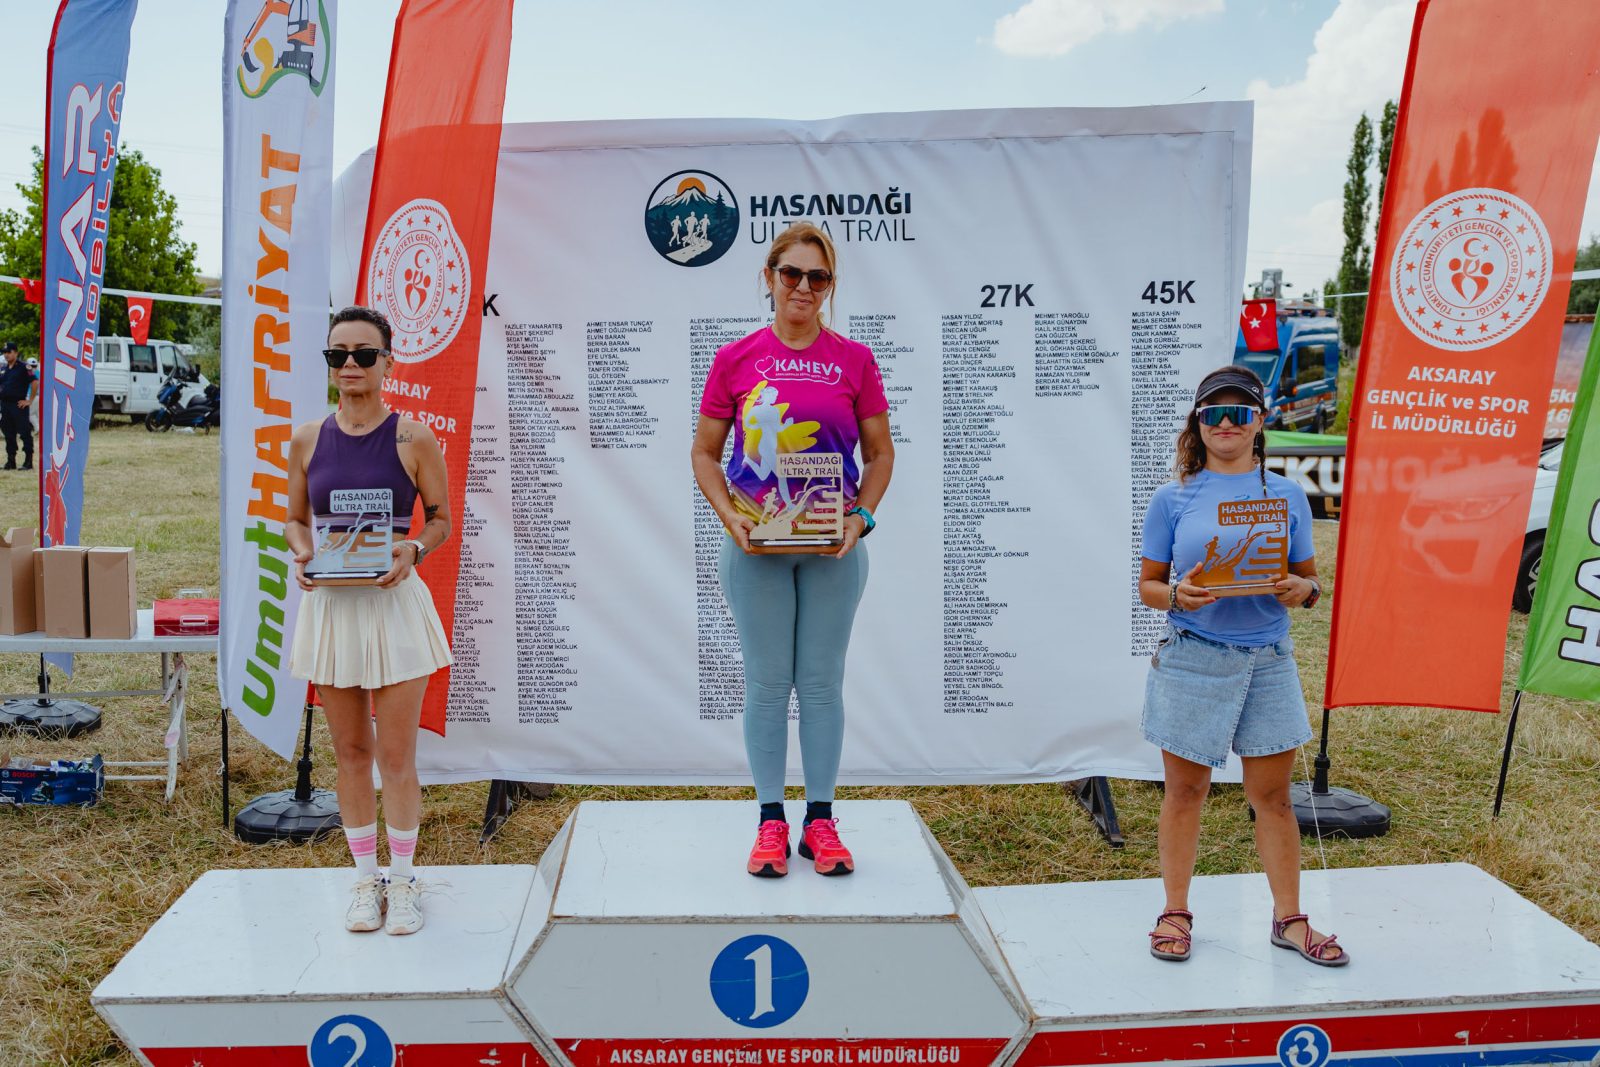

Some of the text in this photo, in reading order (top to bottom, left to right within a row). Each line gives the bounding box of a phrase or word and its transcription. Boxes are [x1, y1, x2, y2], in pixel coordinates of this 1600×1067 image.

[750, 186, 911, 217] HASANDAĞI
[840, 218, 915, 242] TRAIL
[1464, 222, 1504, 238] GENÇLİK
[1509, 248, 1518, 274] SPOR
[980, 284, 1034, 308] 27K
[1142, 280, 1196, 304] 45K
[776, 359, 834, 376] KAHEV
[1408, 366, 1496, 385] AKSARAY
[1367, 388, 1530, 414] GENÇLİK ve SPOR
[418, 410, 456, 434] SPOR
[1371, 411, 1517, 438] İL MÜDÜRLÜĞÜ
[780, 456, 842, 464] HASANDAĞI
[334, 491, 391, 502] HASANDAĞI
[1222, 514, 1255, 524] ULTRA
[536, 606, 558, 614] KÜÇÜK
[744, 944, 775, 1020] 1
[328, 1022, 366, 1067] 2
[610, 1049, 688, 1064] AKSARAY
[766, 1049, 786, 1064] VE
[790, 1048, 834, 1064] SPOR
[838, 1045, 854, 1064] İL
[858, 1046, 960, 1064] MÜDÜRLÜĞÜ
[1285, 1030, 1320, 1067] 3
